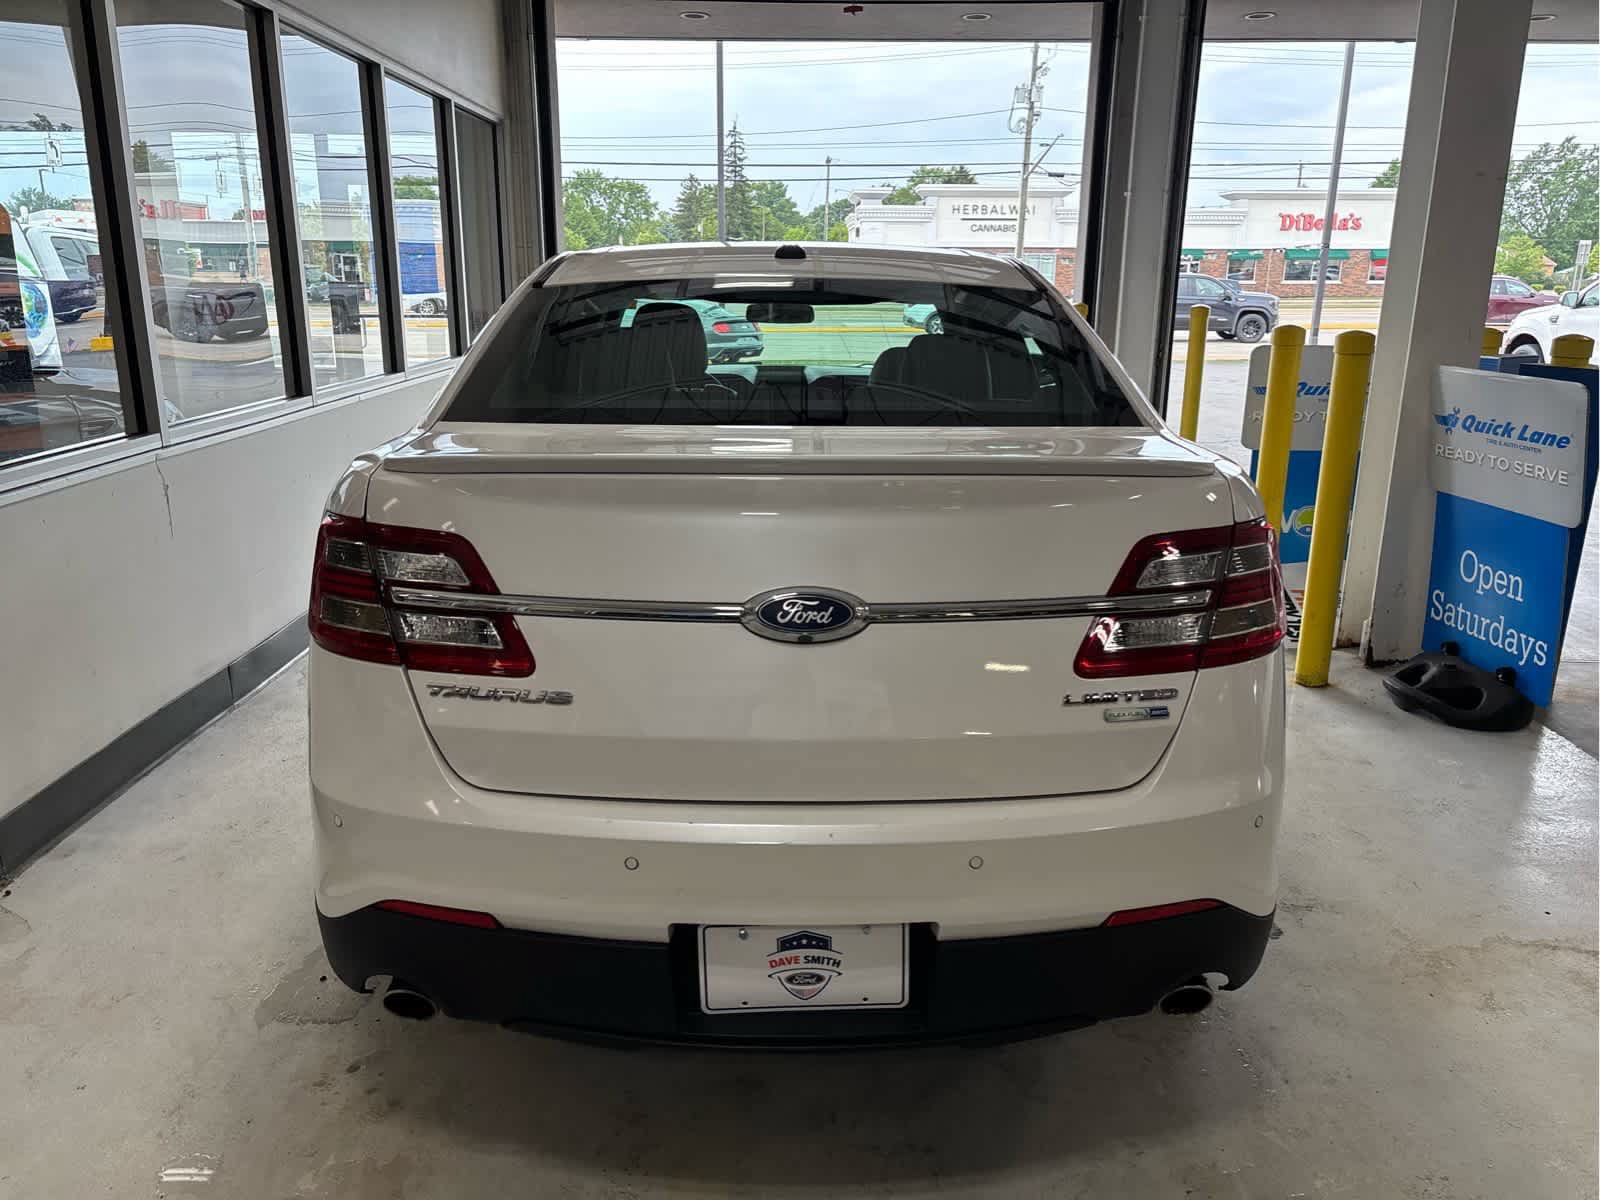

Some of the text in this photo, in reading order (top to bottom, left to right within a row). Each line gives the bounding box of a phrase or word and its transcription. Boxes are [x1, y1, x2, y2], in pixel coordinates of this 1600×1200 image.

[970, 223, 1017, 233] CANNABIS
[1278, 213, 1362, 231] DiBela's
[1461, 414, 1571, 449] Quick Lane
[1434, 443, 1569, 486] READY TO SERVE
[1460, 549, 1525, 602] Open
[776, 599, 835, 624] Ford
[1430, 589, 1548, 666] Saturdays
[425, 682, 574, 706] TAURUS
[1062, 688, 1179, 706] LIMITED
[768, 954, 842, 969] DAVE SMITH
[792, 974, 818, 985] Ford
